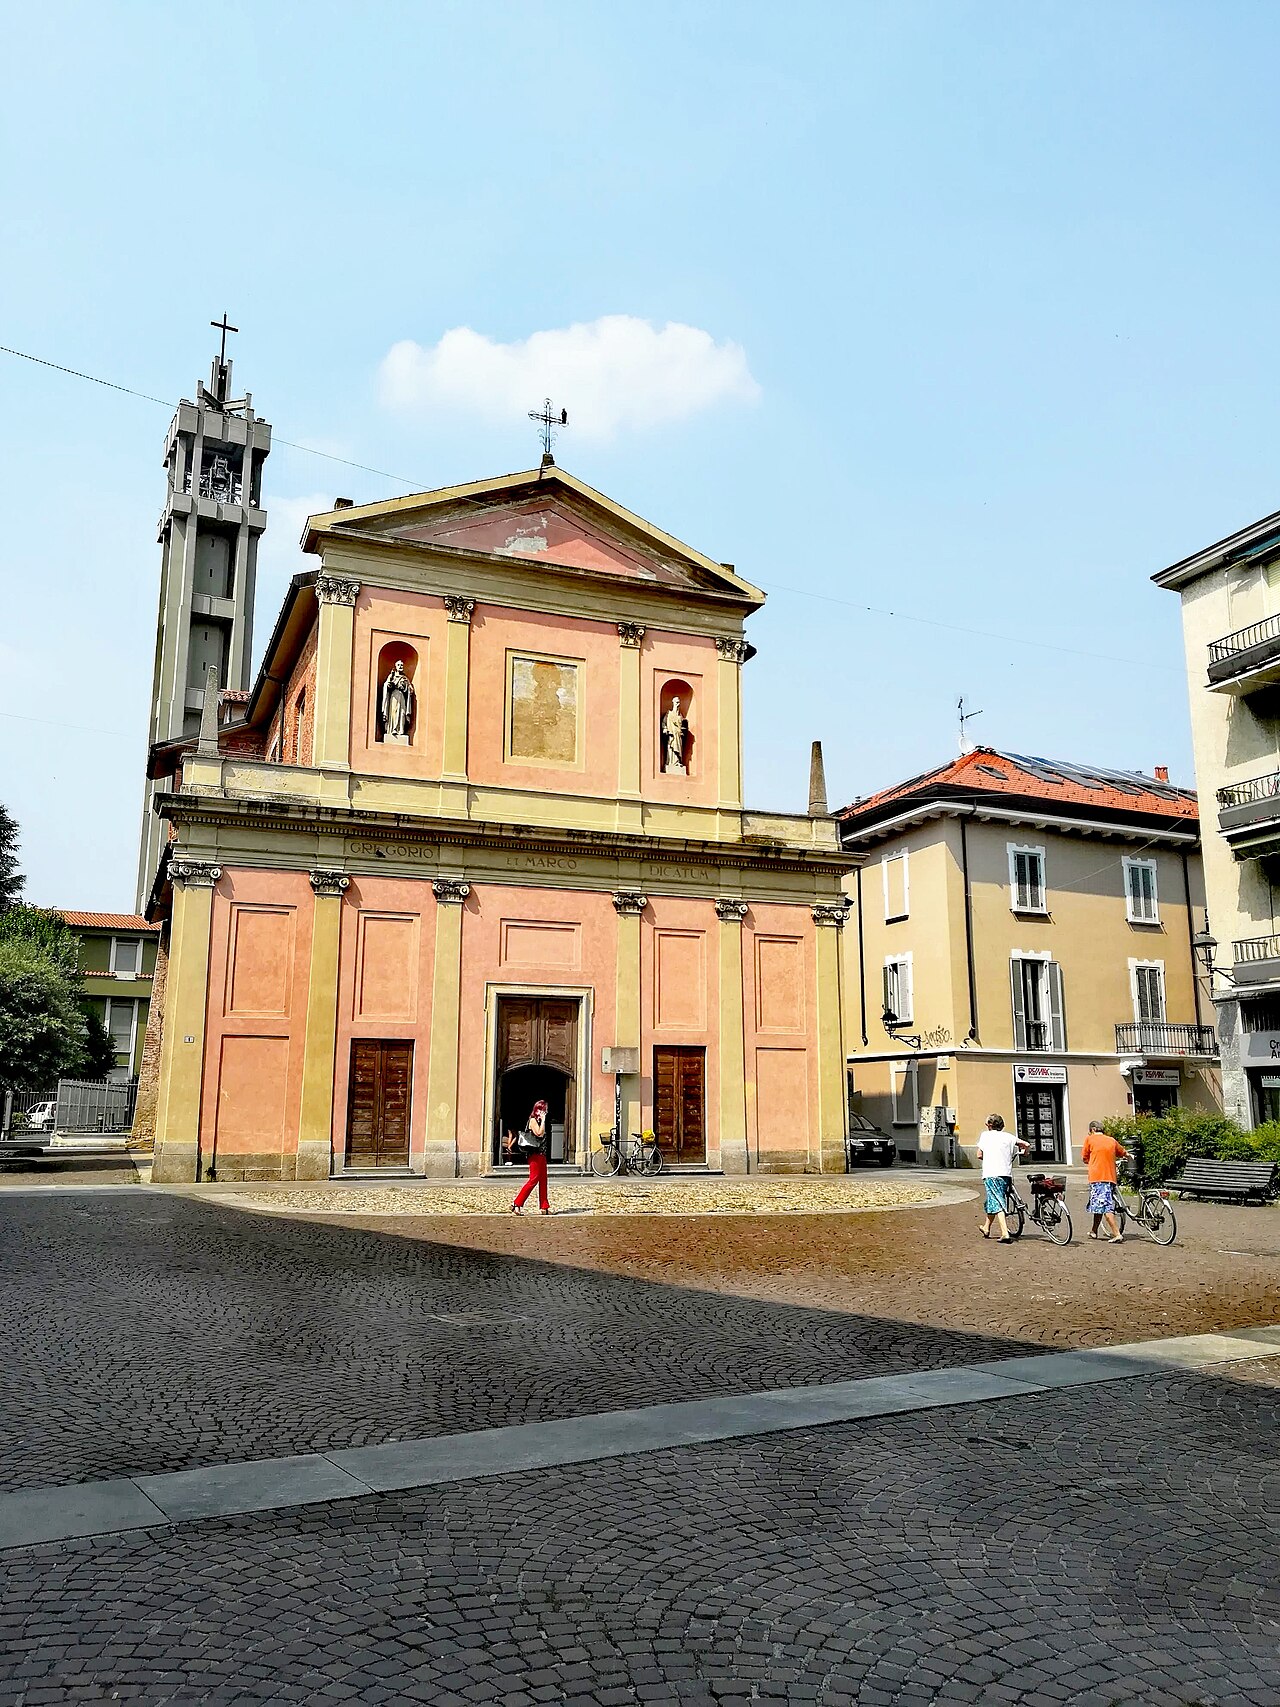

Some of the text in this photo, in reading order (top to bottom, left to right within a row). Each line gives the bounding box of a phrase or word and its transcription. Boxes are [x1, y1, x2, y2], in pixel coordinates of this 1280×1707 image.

[350, 842, 434, 859] GREGORIO
[525, 857, 577, 870] MARCO
[649, 865, 709, 880] DICATUM
